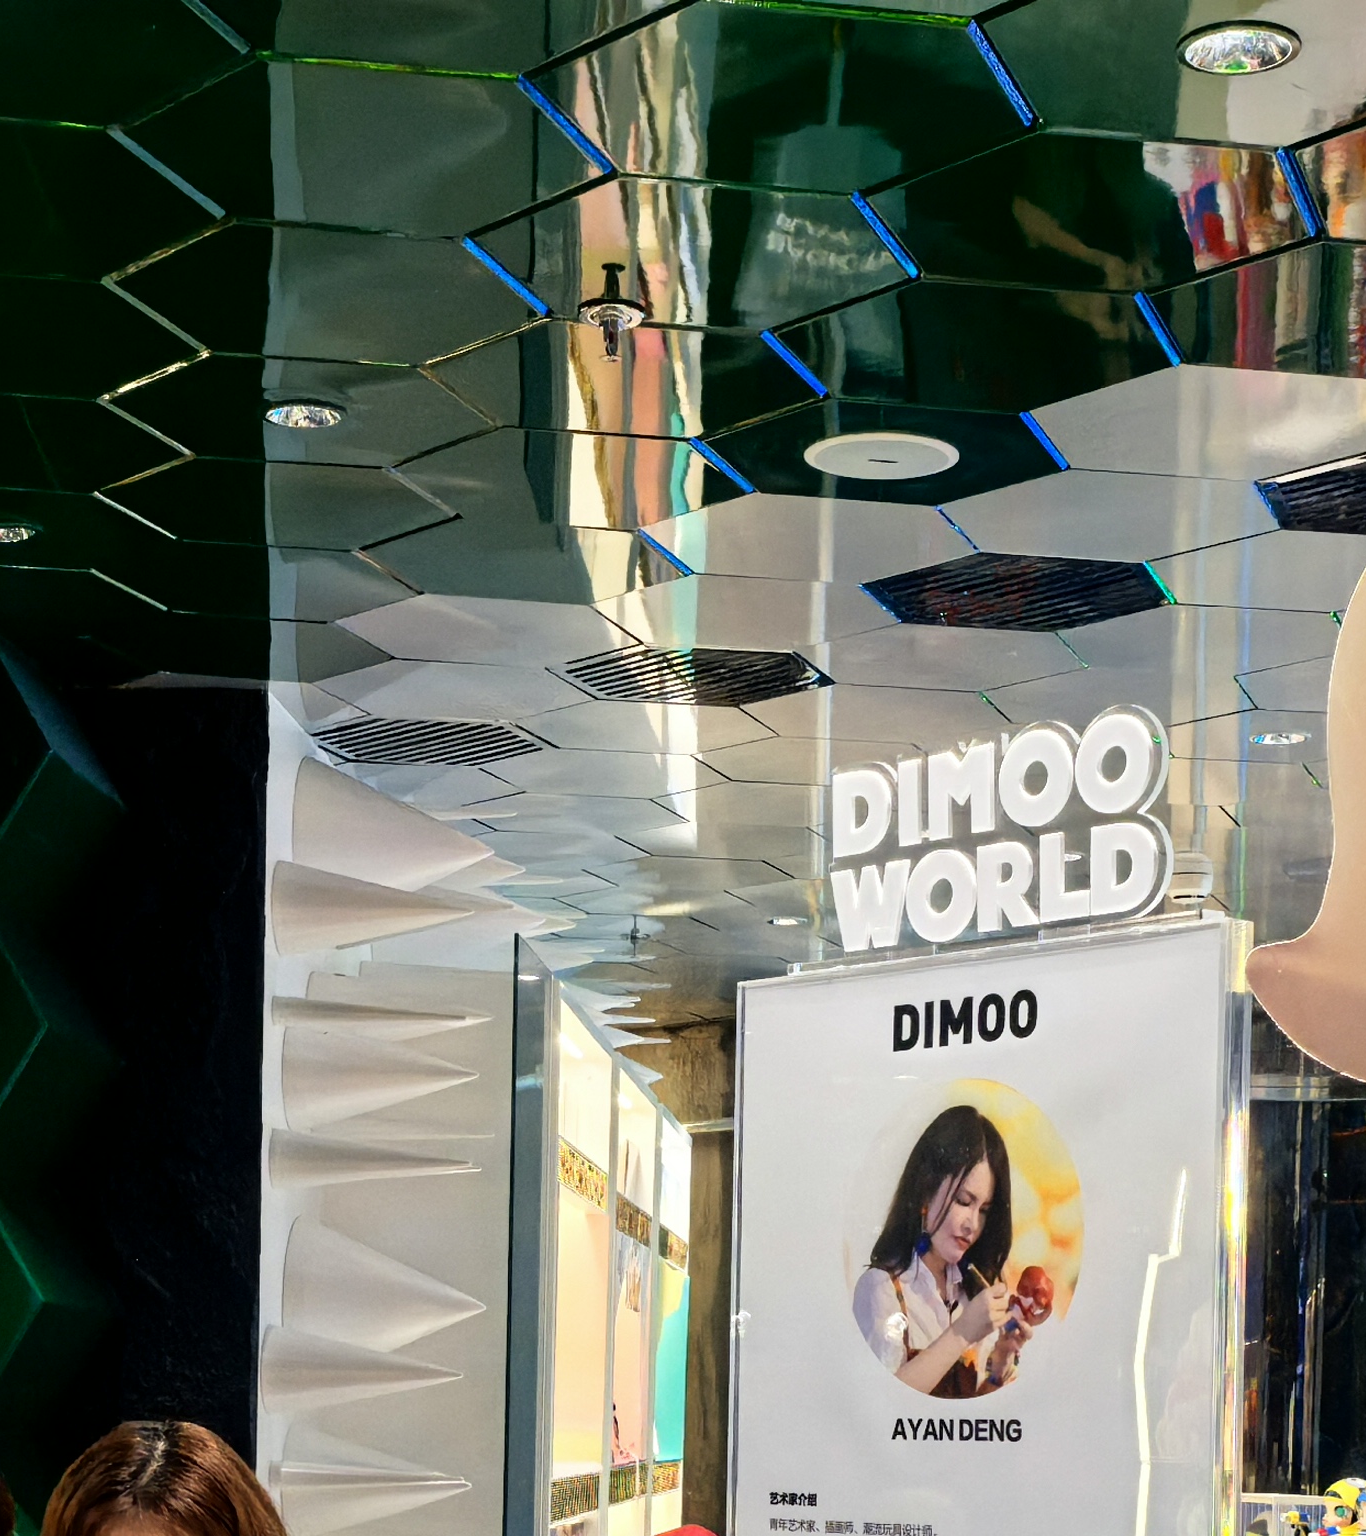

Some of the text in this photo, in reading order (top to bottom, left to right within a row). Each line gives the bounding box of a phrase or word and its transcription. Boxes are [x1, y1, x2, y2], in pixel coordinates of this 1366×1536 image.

[831, 709, 1161, 859] DIMOO
[830, 821, 1165, 952] WORLD
[892, 988, 1038, 1053] DIMOO
[891, 1417, 1023, 1442] AYAN DENG
[769, 1491, 818, 1507] 艺术家介绍
